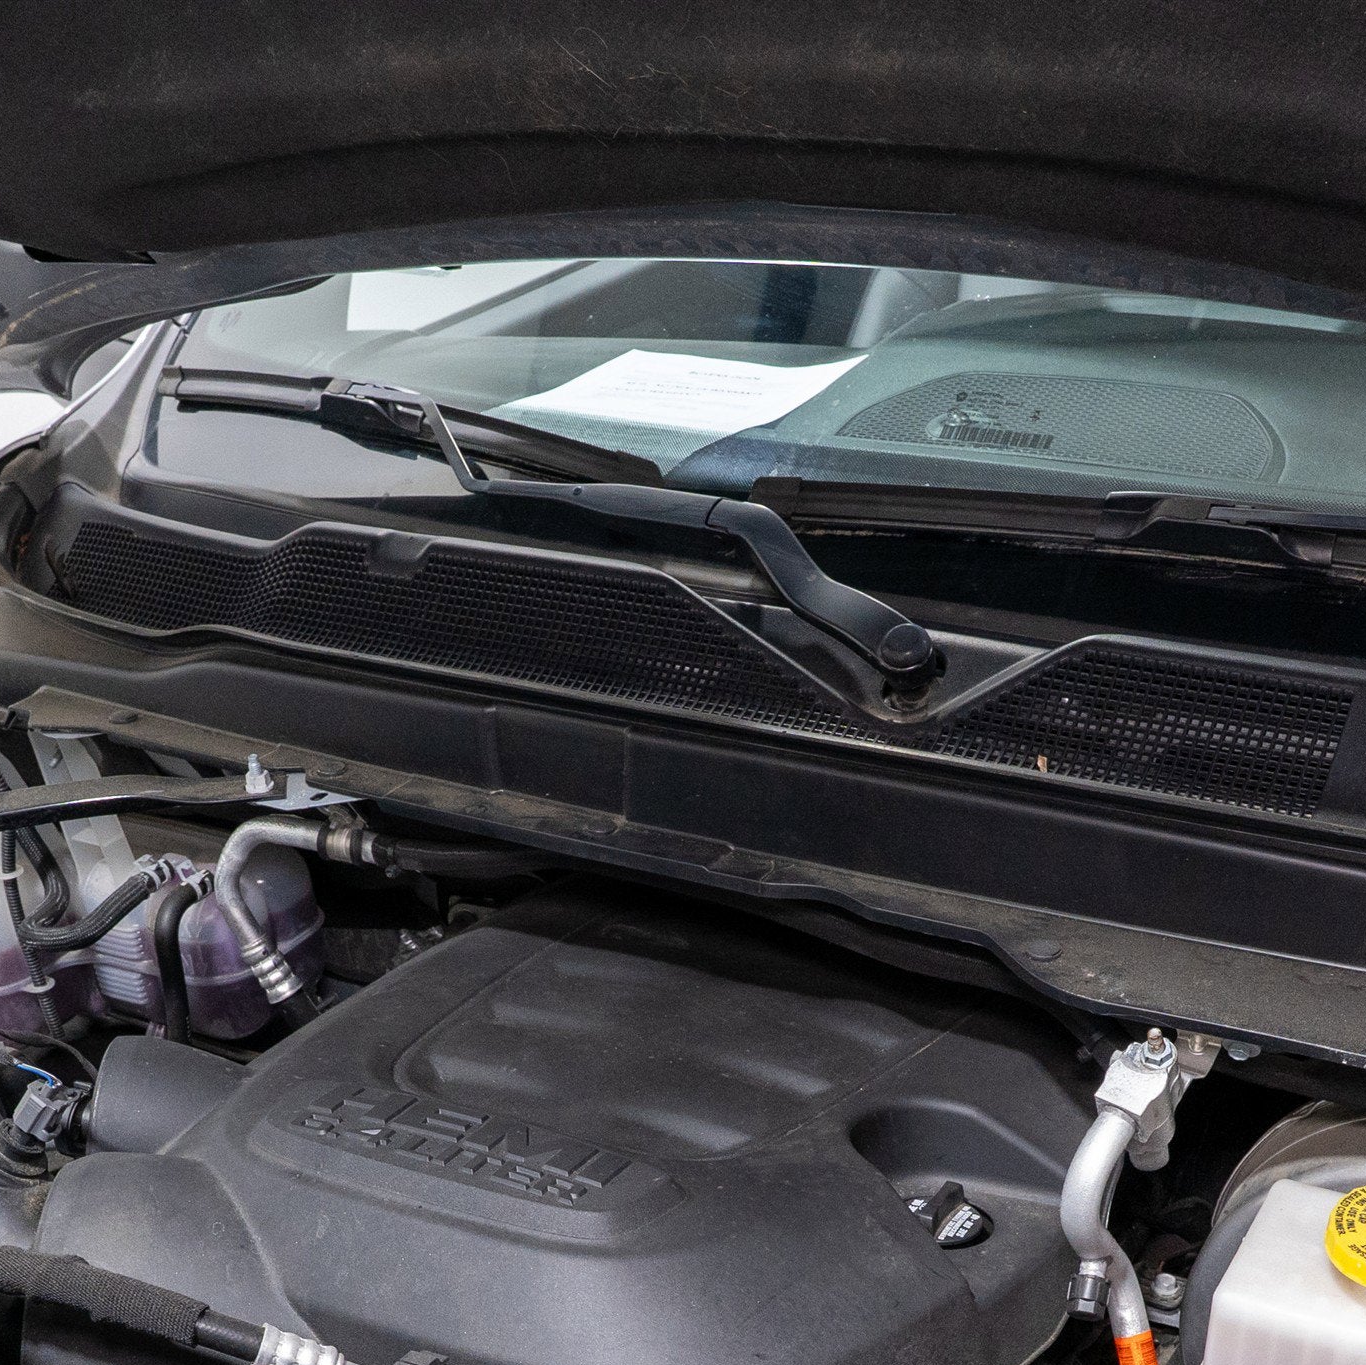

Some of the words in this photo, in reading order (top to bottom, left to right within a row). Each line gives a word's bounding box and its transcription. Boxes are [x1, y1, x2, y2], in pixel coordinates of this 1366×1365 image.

[307, 1087, 634, 1189] HEMI
[395, 1135, 589, 1207] LITER
[1340, 1191, 1361, 1207] SEALED
[1347, 1207, 1359, 1218] USE
